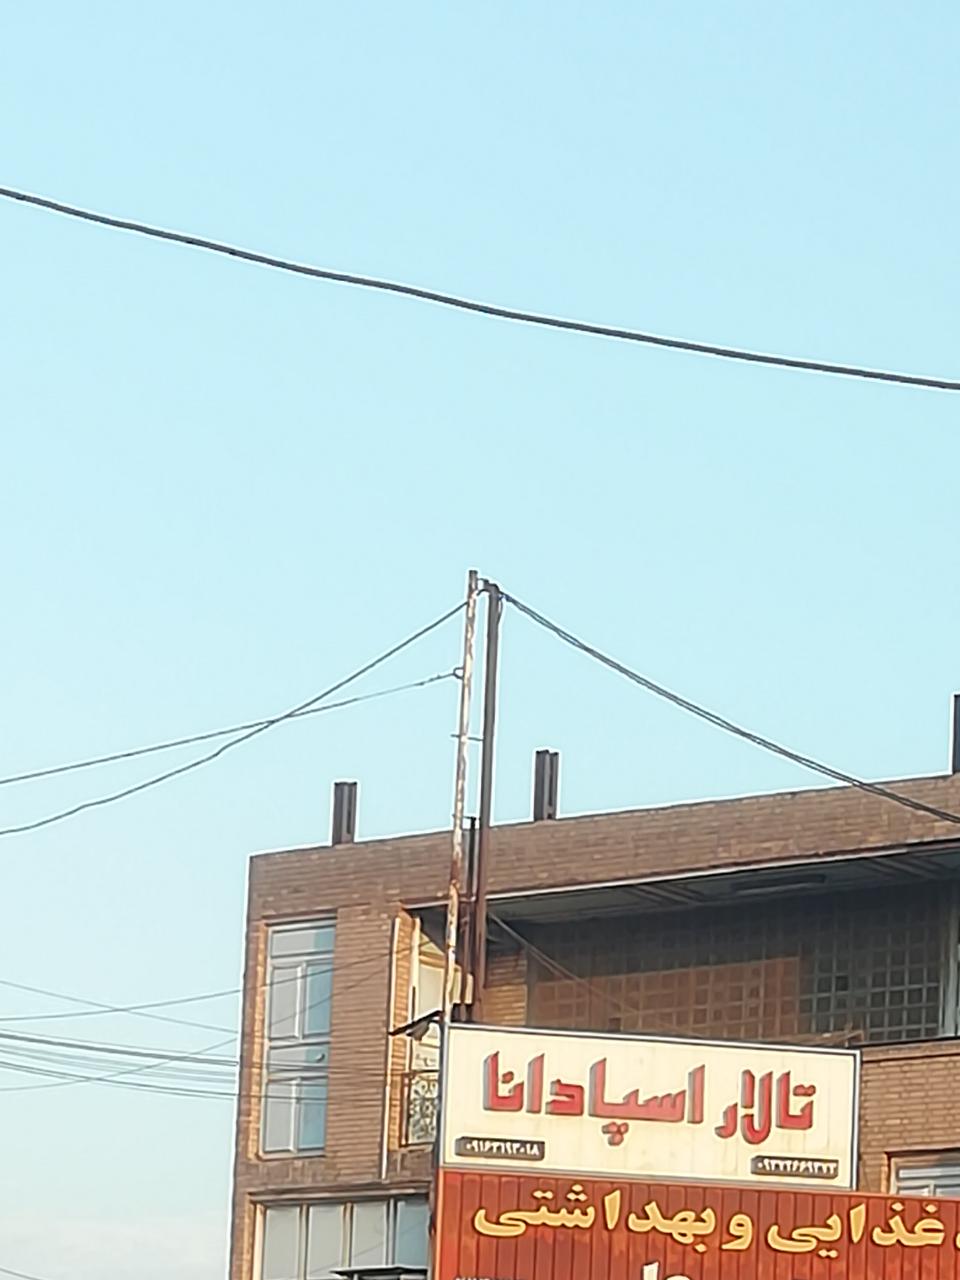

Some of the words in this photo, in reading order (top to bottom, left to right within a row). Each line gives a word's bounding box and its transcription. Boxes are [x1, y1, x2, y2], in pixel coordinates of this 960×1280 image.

[482, 1050, 706, 1147] اسپادانا
[715, 1069, 817, 1146] تالار
[766, 1201, 946, 1259] غذایی
